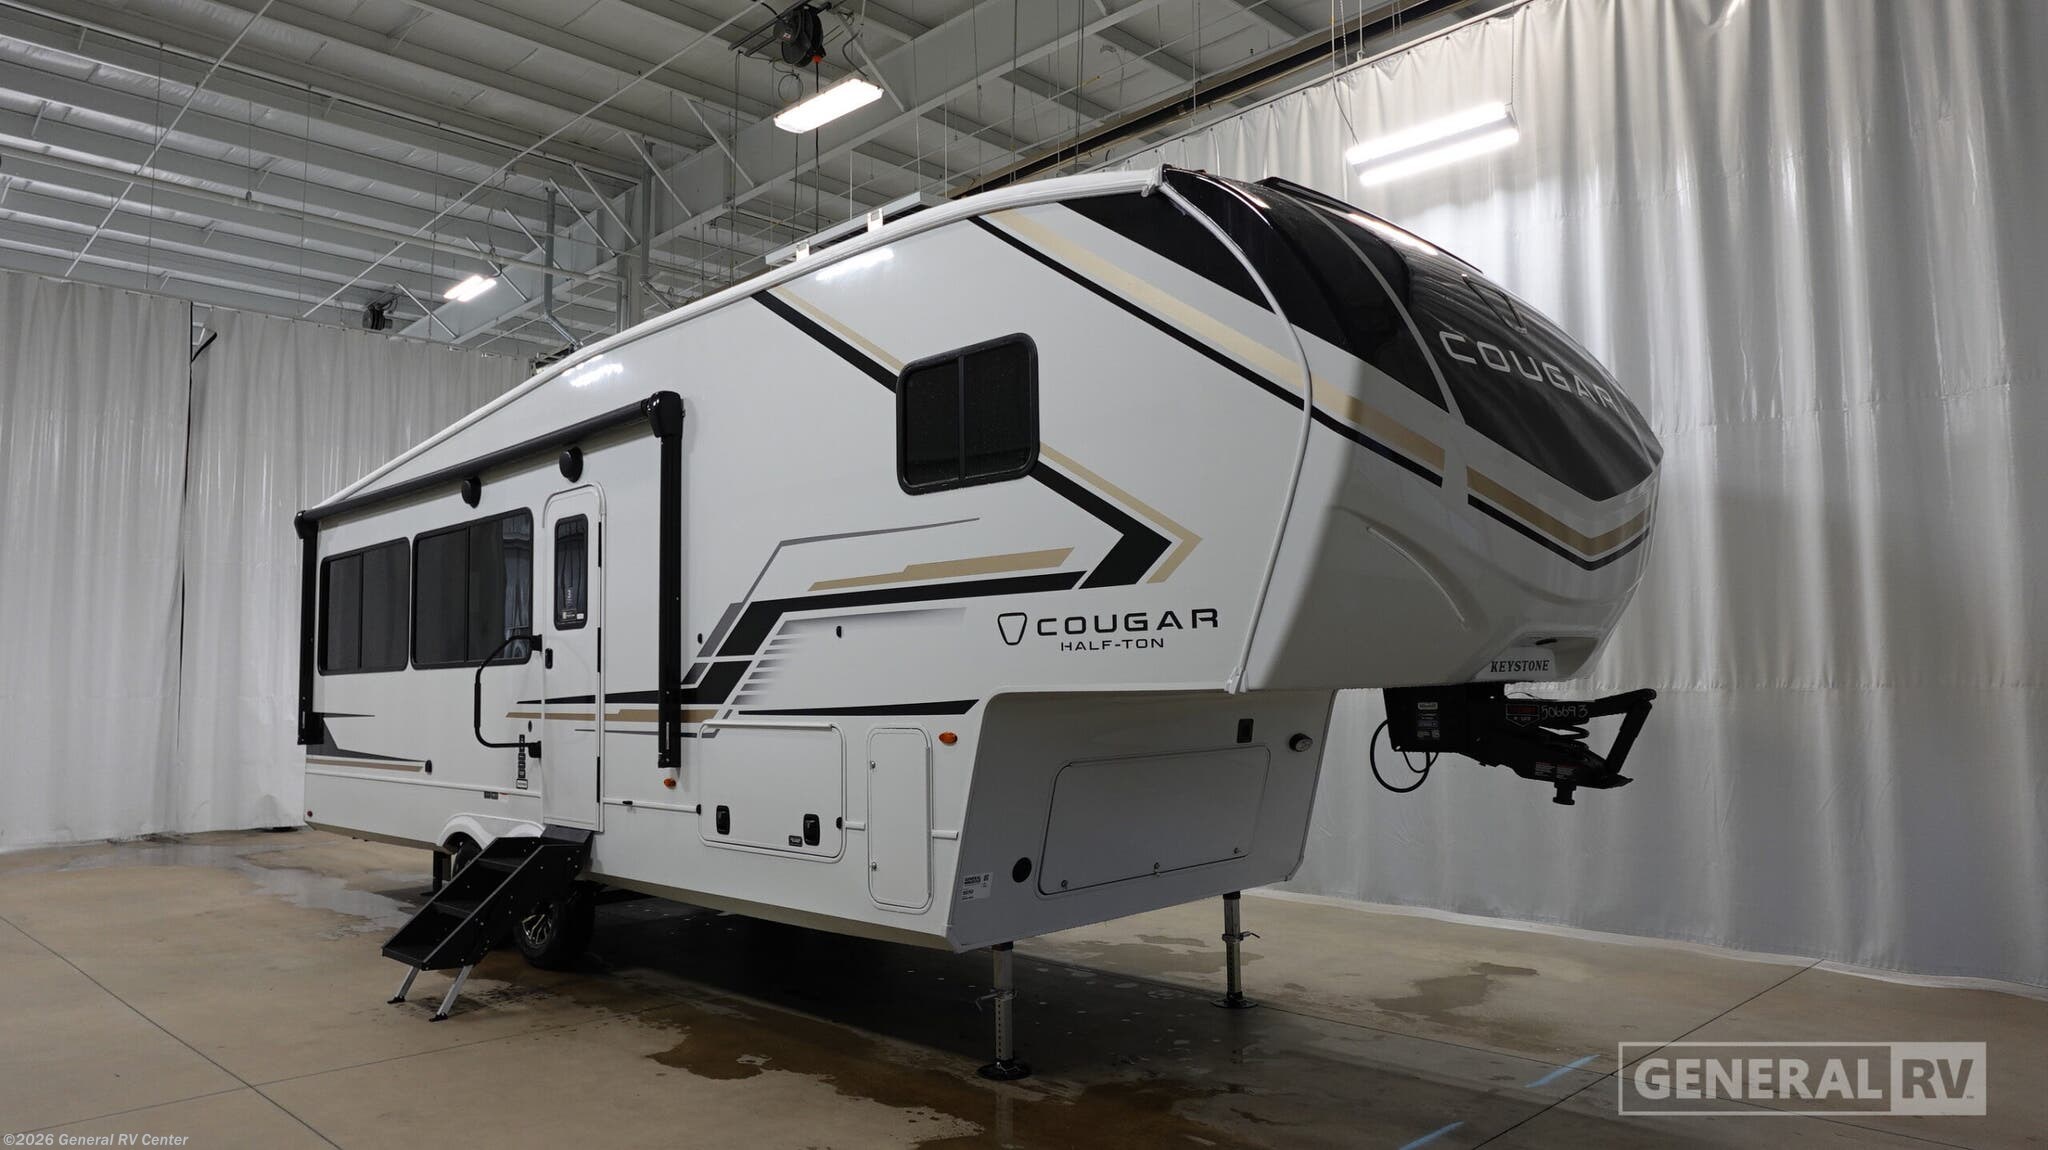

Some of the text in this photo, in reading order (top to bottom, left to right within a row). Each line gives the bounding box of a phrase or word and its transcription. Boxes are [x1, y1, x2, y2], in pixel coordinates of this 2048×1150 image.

[1439, 331, 1620, 411] COUGAR
[1037, 608, 1219, 636] COUGAR
[1060, 638, 1165, 652] HALF-TON
[1490, 660, 1549, 672] KEYSTONE
